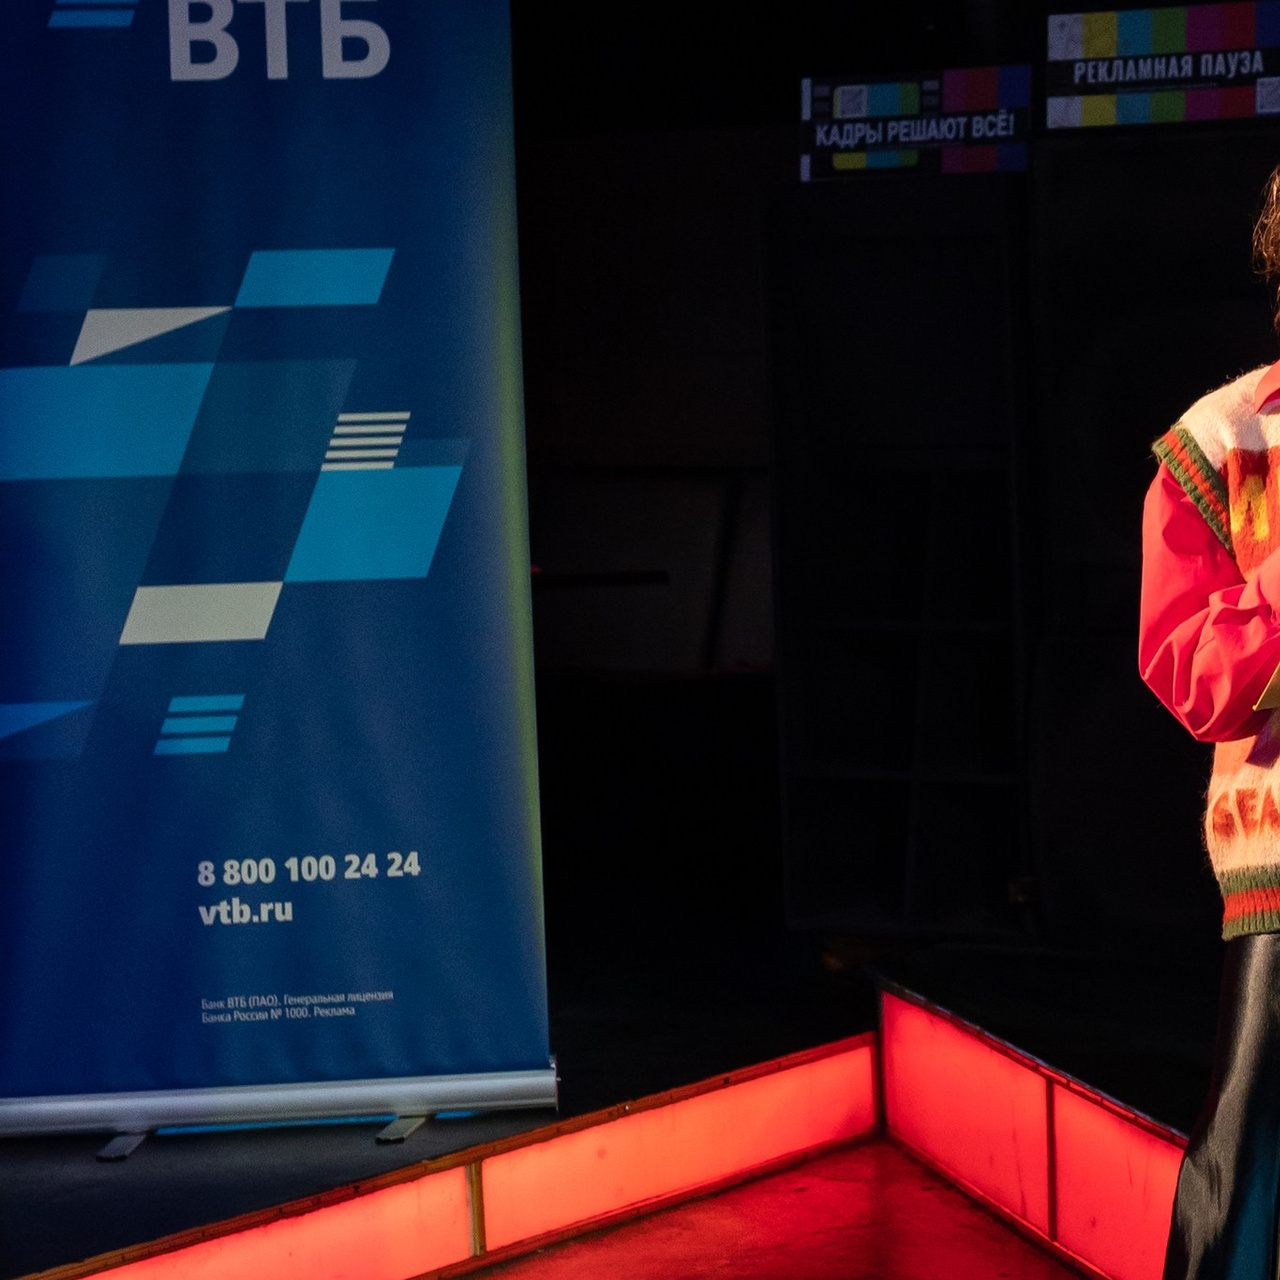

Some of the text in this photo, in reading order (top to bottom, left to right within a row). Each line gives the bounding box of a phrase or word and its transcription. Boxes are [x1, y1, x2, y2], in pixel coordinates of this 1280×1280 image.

[1073, 49, 1264, 85] РЕКЛАМНАЯ ПАУЗА
[815, 109, 1015, 148] КАДРЫ РЕШАЮТ ВСЁ!
[198, 850, 422, 887] 8 800 100 24 24
[198, 896, 294, 926] vtb.ru
[201, 990, 394, 1010] Банк ВТБ (ПАО). Генеральная лицензия
[201, 1012, 232, 1023] Банка
[234, 1010, 269, 1022] России
[285, 1007, 312, 1019] 1000.
[313, 1005, 356, 1018] Реклама
